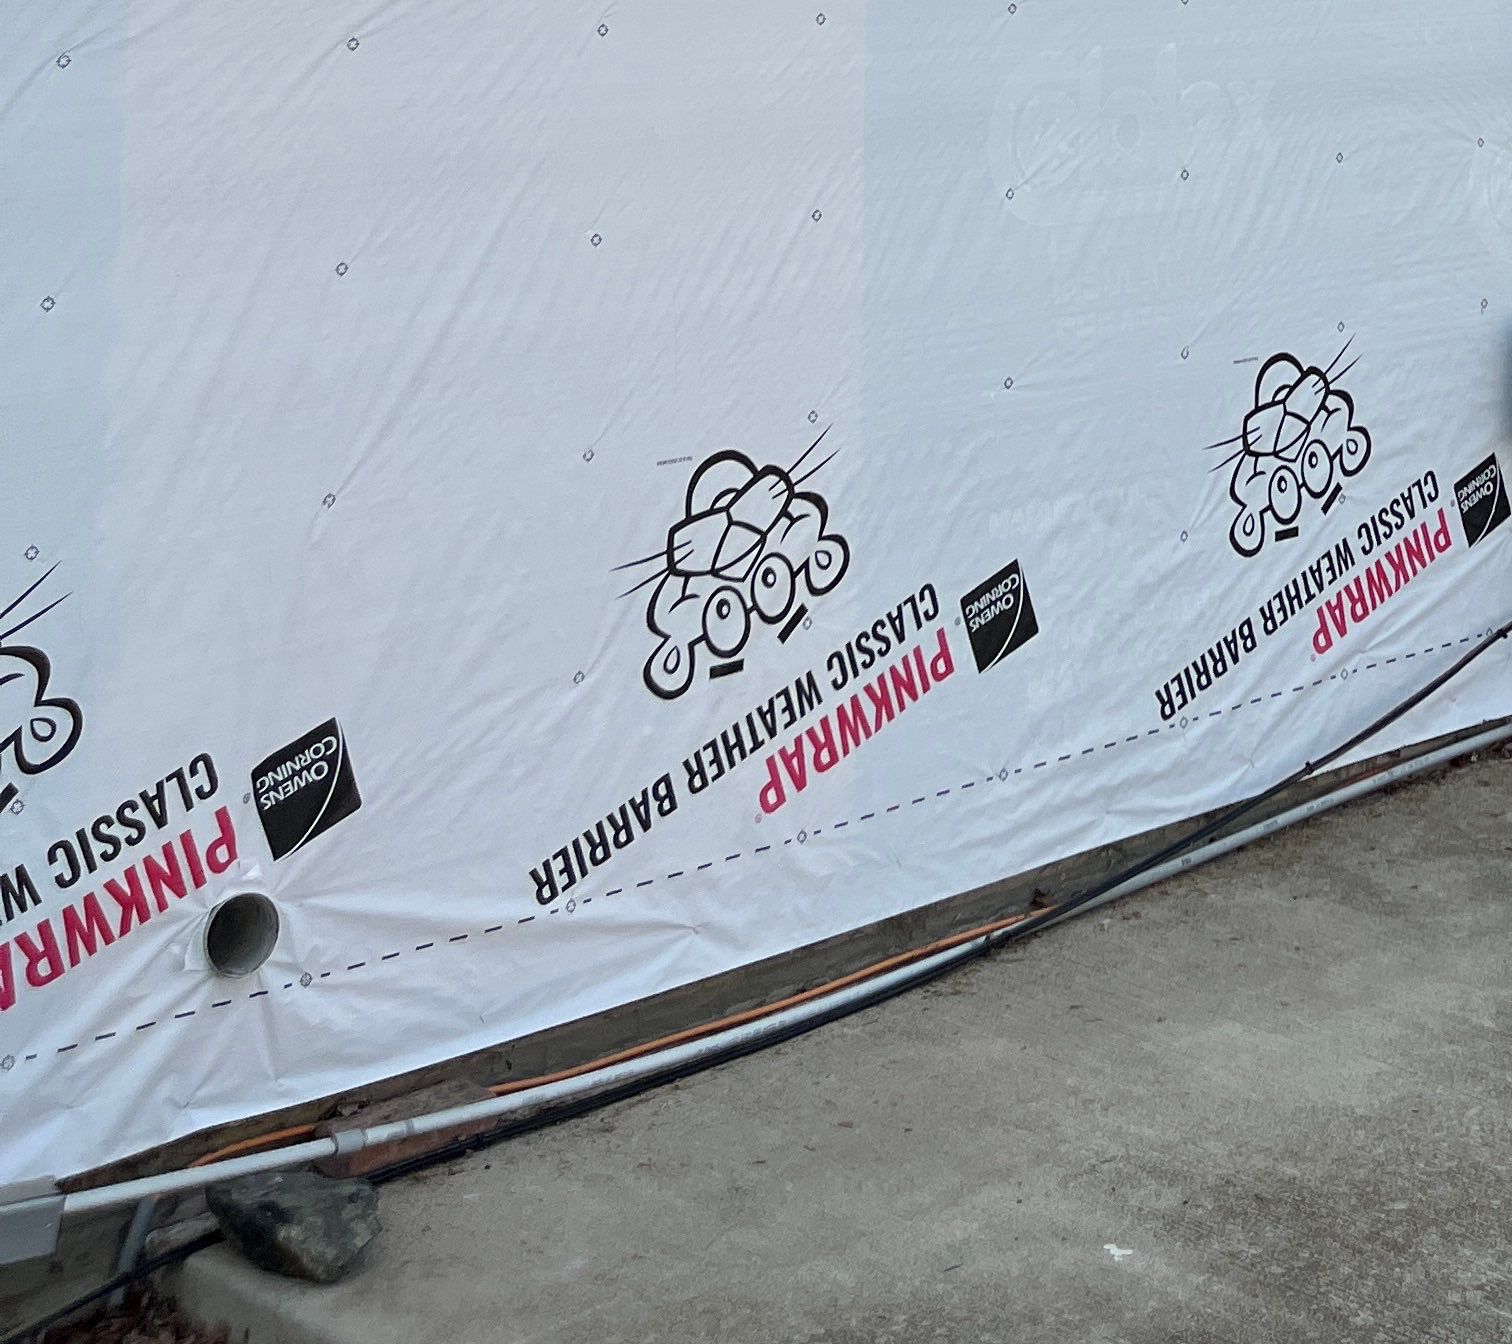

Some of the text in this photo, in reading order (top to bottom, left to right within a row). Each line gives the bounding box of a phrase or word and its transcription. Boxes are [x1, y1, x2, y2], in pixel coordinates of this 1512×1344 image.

[1457, 463, 1497, 500] CORNING
[1460, 480, 1495, 515] OWENS
[964, 572, 1021, 621] CORNING
[1154, 469, 1440, 722] CLASSIC WEATHER BARRIER
[1311, 507, 1453, 656] PINKWRAP
[969, 594, 1015, 634] OWENS
[527, 582, 940, 906] CLASSIC WEATHER BARRIER
[758, 625, 956, 815] PINKWRAP
[256, 734, 338, 794] CORNING
[262, 760, 330, 811] OWENS
[47, 751, 219, 889] CLASSIC
